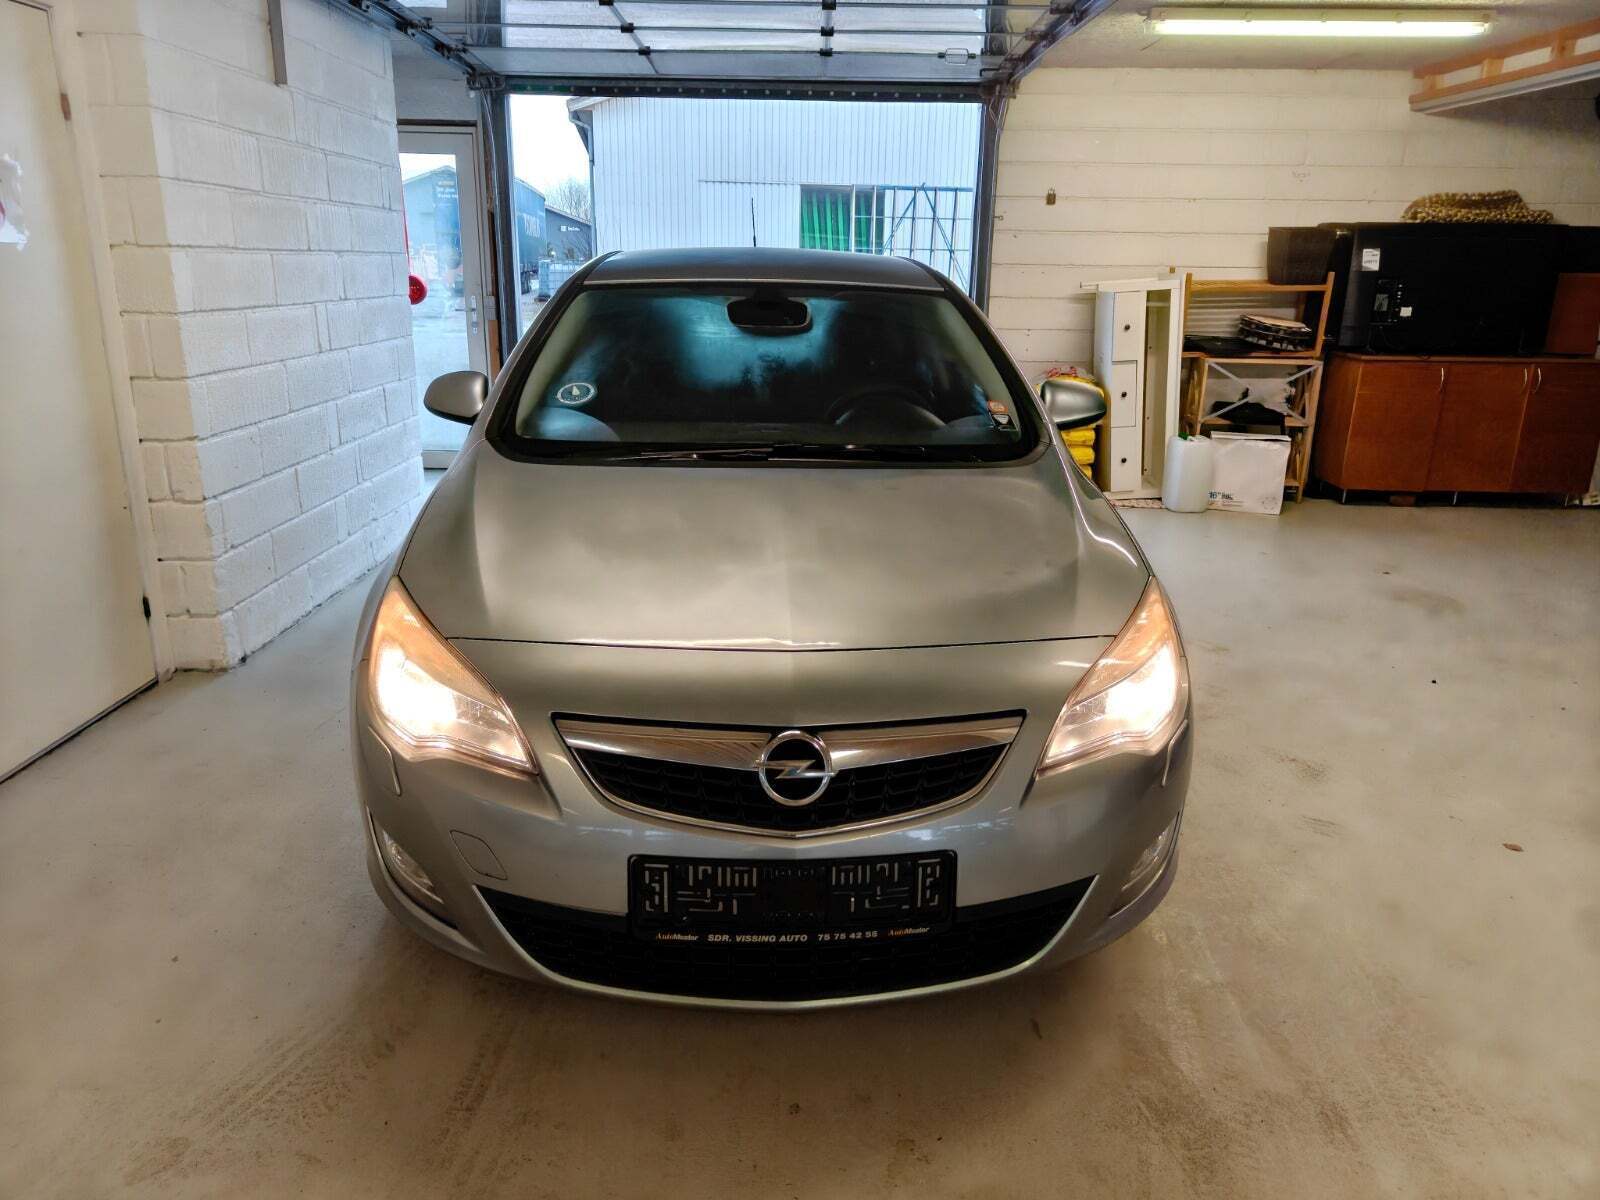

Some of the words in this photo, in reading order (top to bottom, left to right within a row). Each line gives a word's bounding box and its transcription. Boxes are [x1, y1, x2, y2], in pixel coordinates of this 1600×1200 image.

[736, 934, 776, 942] VISSING
[779, 934, 808, 942] AUTO
[849, 932, 863, 940] 42
